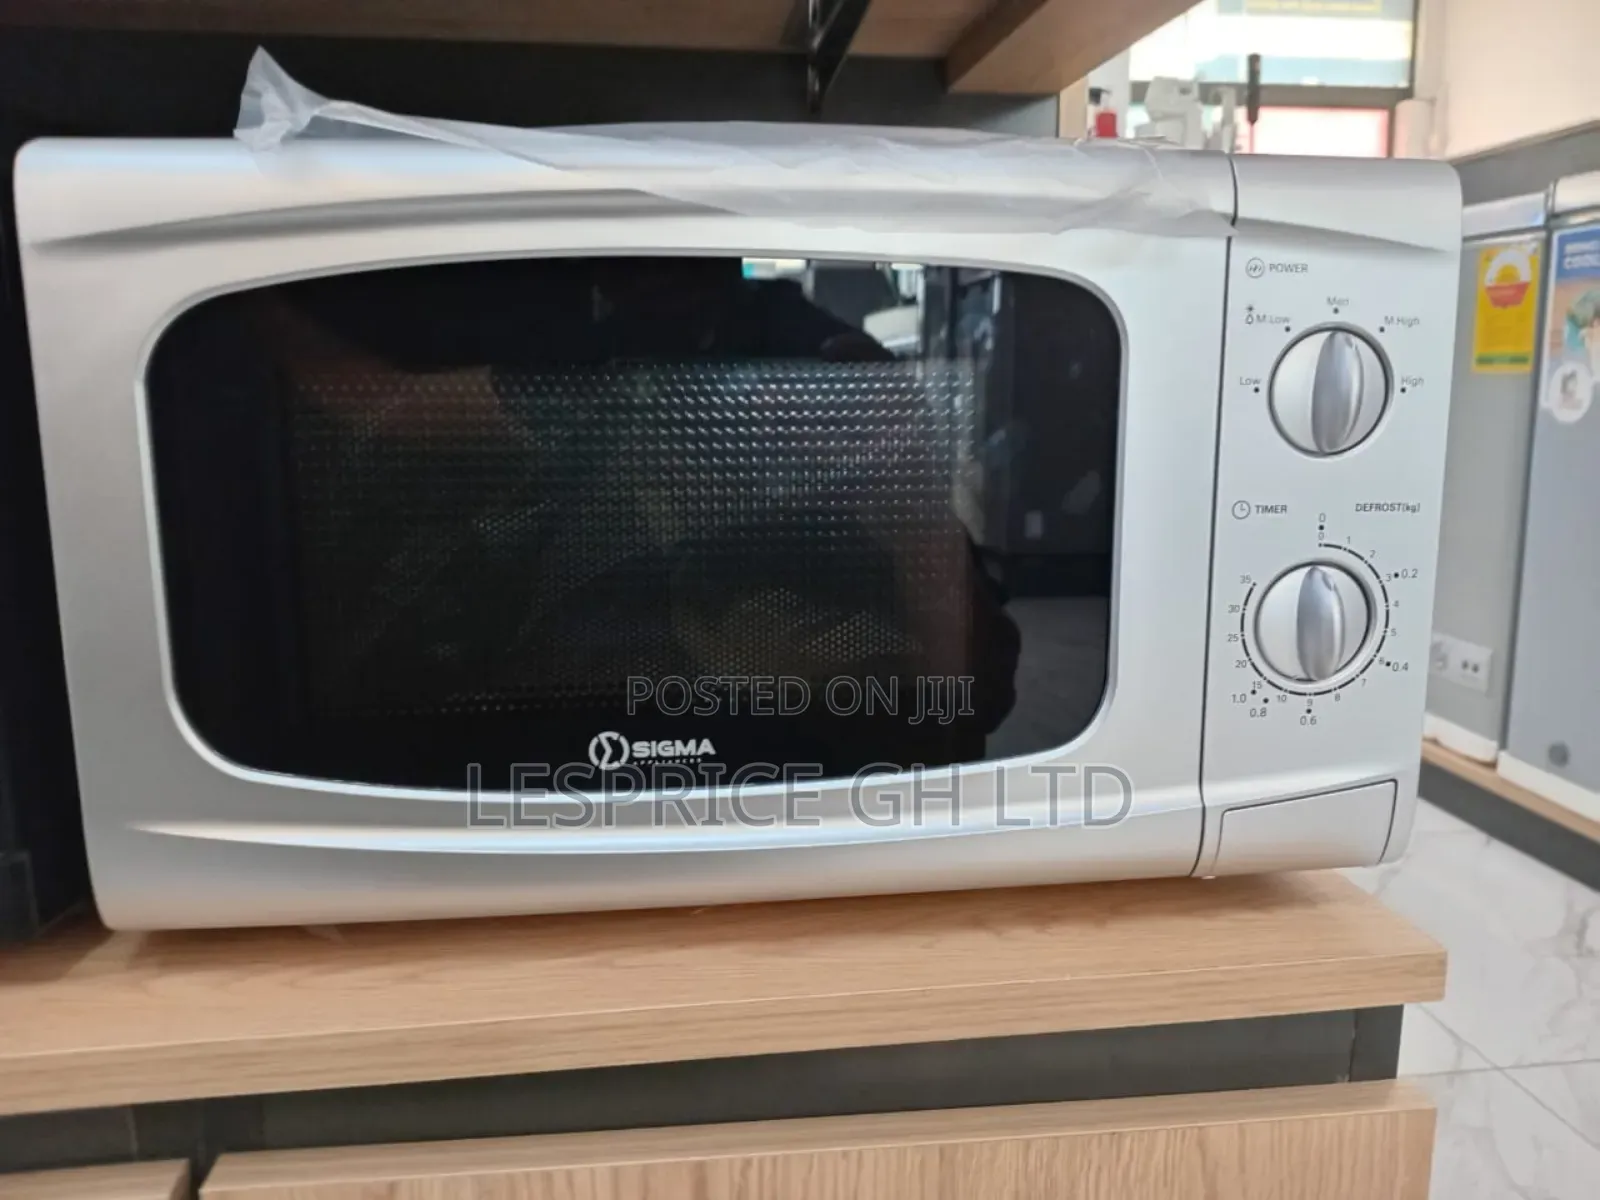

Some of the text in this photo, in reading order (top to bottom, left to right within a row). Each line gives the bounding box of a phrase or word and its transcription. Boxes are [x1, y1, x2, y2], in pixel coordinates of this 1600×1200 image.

[1269, 263, 1308, 273] POWER
[1239, 376, 1261, 386] Low
[1401, 376, 1424, 388] High
[1256, 504, 1287, 515] TIMER
[1355, 502, 1421, 514] DEFROST(kg)
[1370, 549, 1376, 559] 2
[1401, 568, 1418, 579] 0.2
[1228, 604, 1240, 613] 30
[1227, 633, 1239, 643] 25
[1235, 659, 1247, 669] 20
[1392, 662, 1409, 672] 0.4
[1232, 693, 1247, 704] 1.0
[1277, 693, 1287, 703] 10
[1250, 708, 1267, 718] 0.8
[1299, 715, 1317, 726] 0.6
[631, 738, 717, 758] SIGMA
